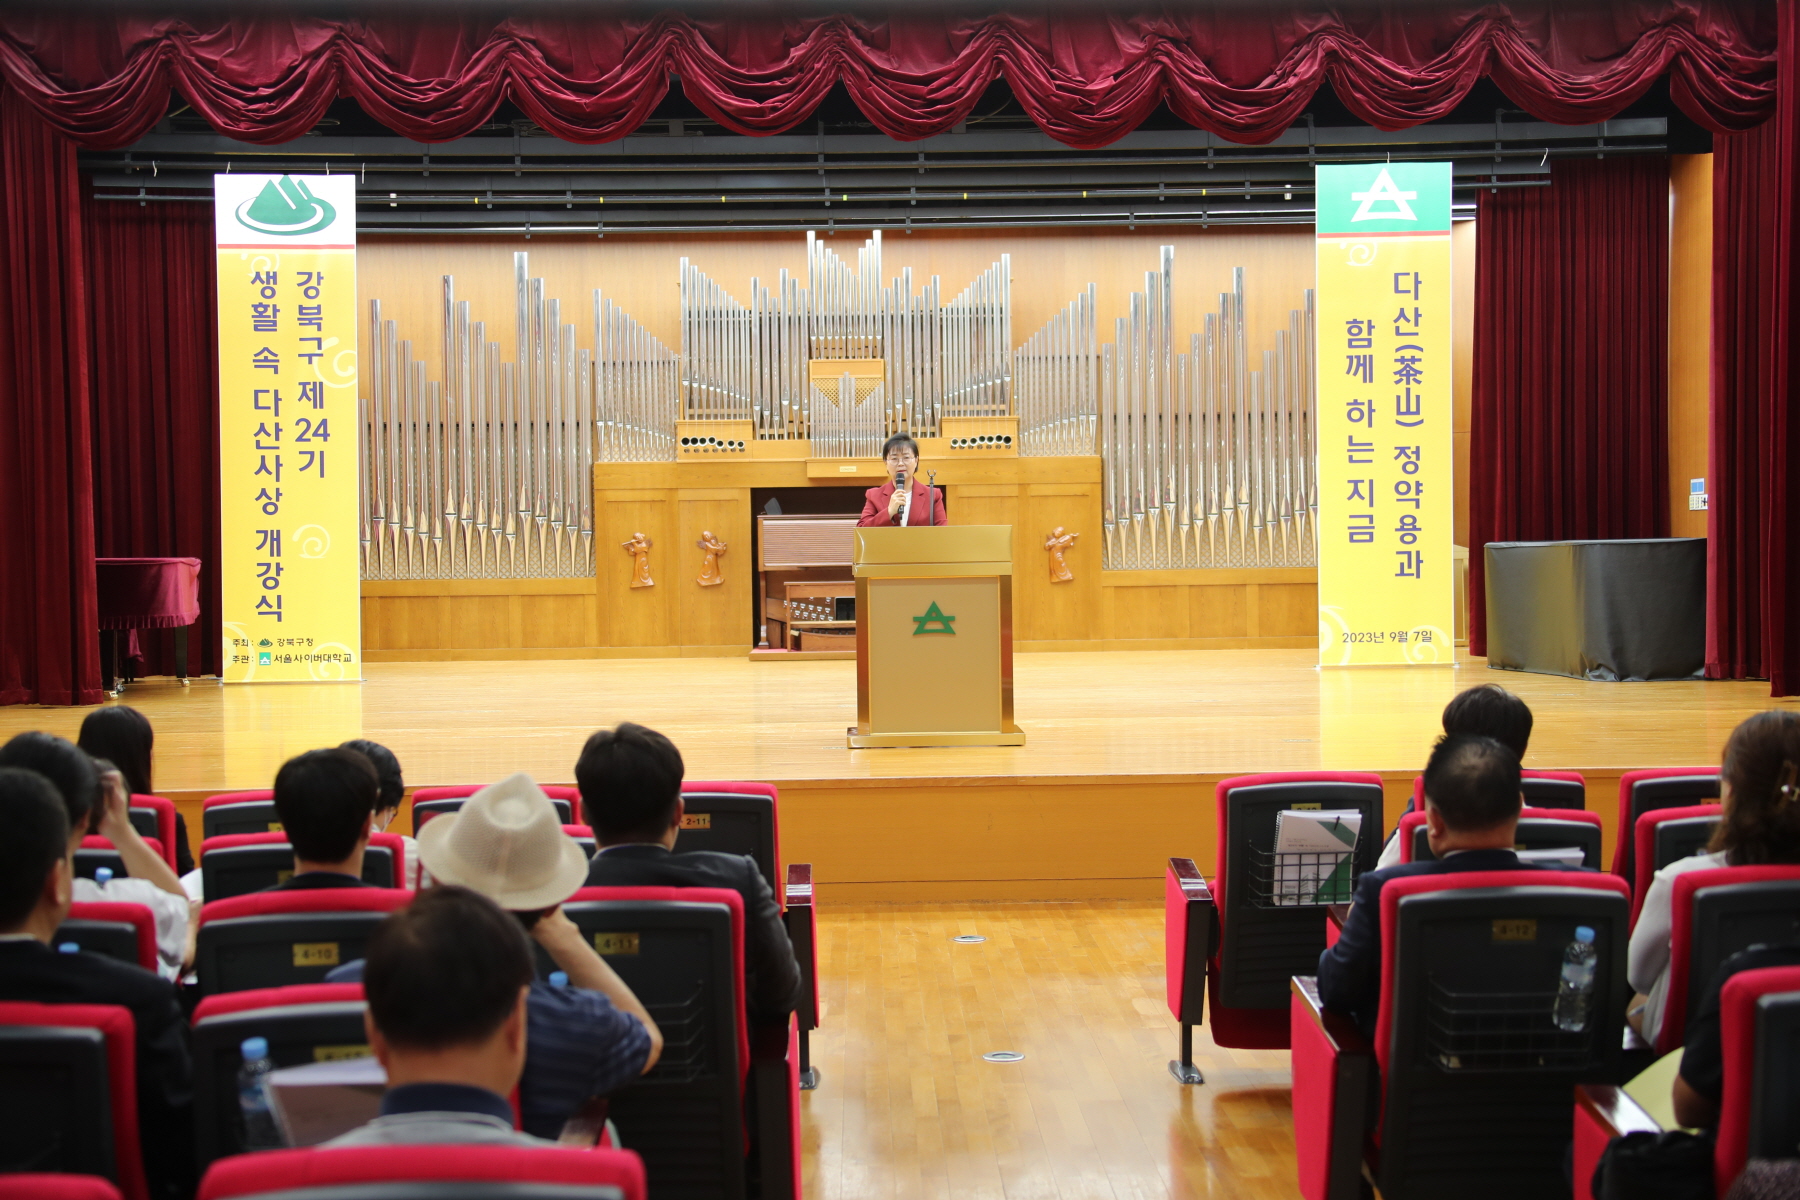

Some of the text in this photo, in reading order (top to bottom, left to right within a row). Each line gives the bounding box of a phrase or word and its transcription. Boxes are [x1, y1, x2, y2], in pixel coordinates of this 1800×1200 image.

[294, 271, 331, 479] 강북구 제24기
[1345, 318, 1376, 543] 함께 하는 지금
[250, 271, 284, 623] 생활 속 다산사상 개강식
[1393, 445, 1424, 579] 정약용과
[273, 653, 352, 664] 서울사이버대학교
[276, 637, 314, 648] 강북구청
[1342, 630, 1432, 644] 2023년 9월 7일
